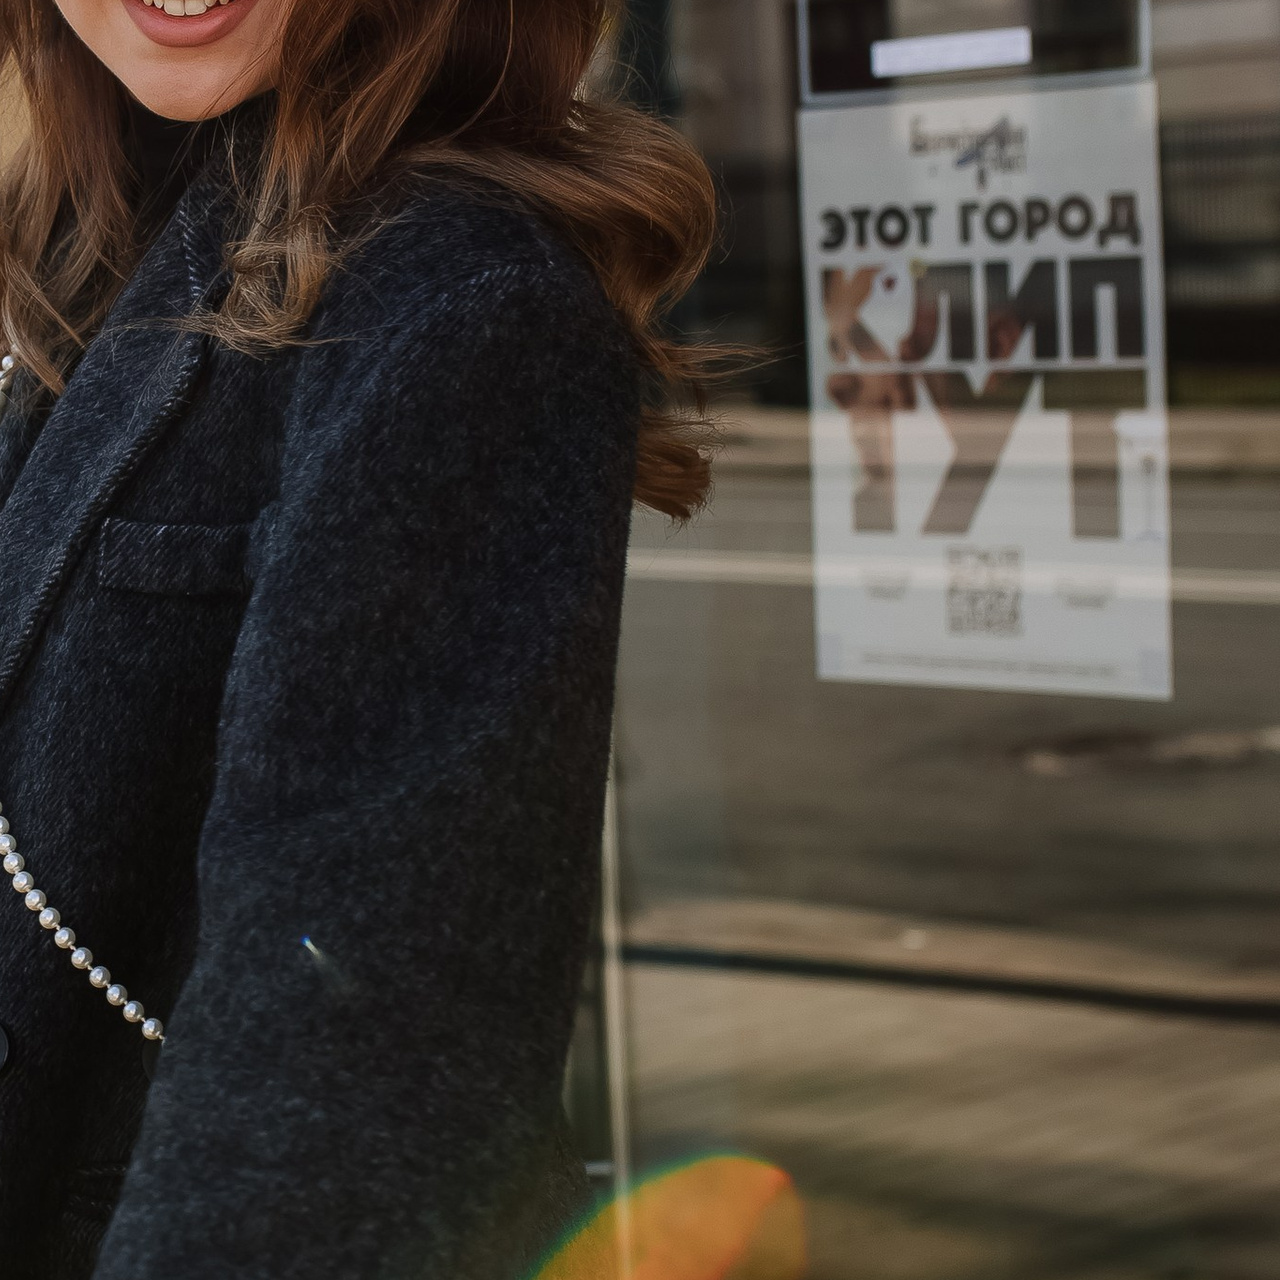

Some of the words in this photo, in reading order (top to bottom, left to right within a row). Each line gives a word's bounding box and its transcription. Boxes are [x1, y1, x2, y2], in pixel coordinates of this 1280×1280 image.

[819, 201, 935, 251] ЭТОТ
[958, 191, 1141, 248] ГОРОД
[822, 257, 1144, 363] КЛИП
[826, 369, 1149, 540] ТУТ
